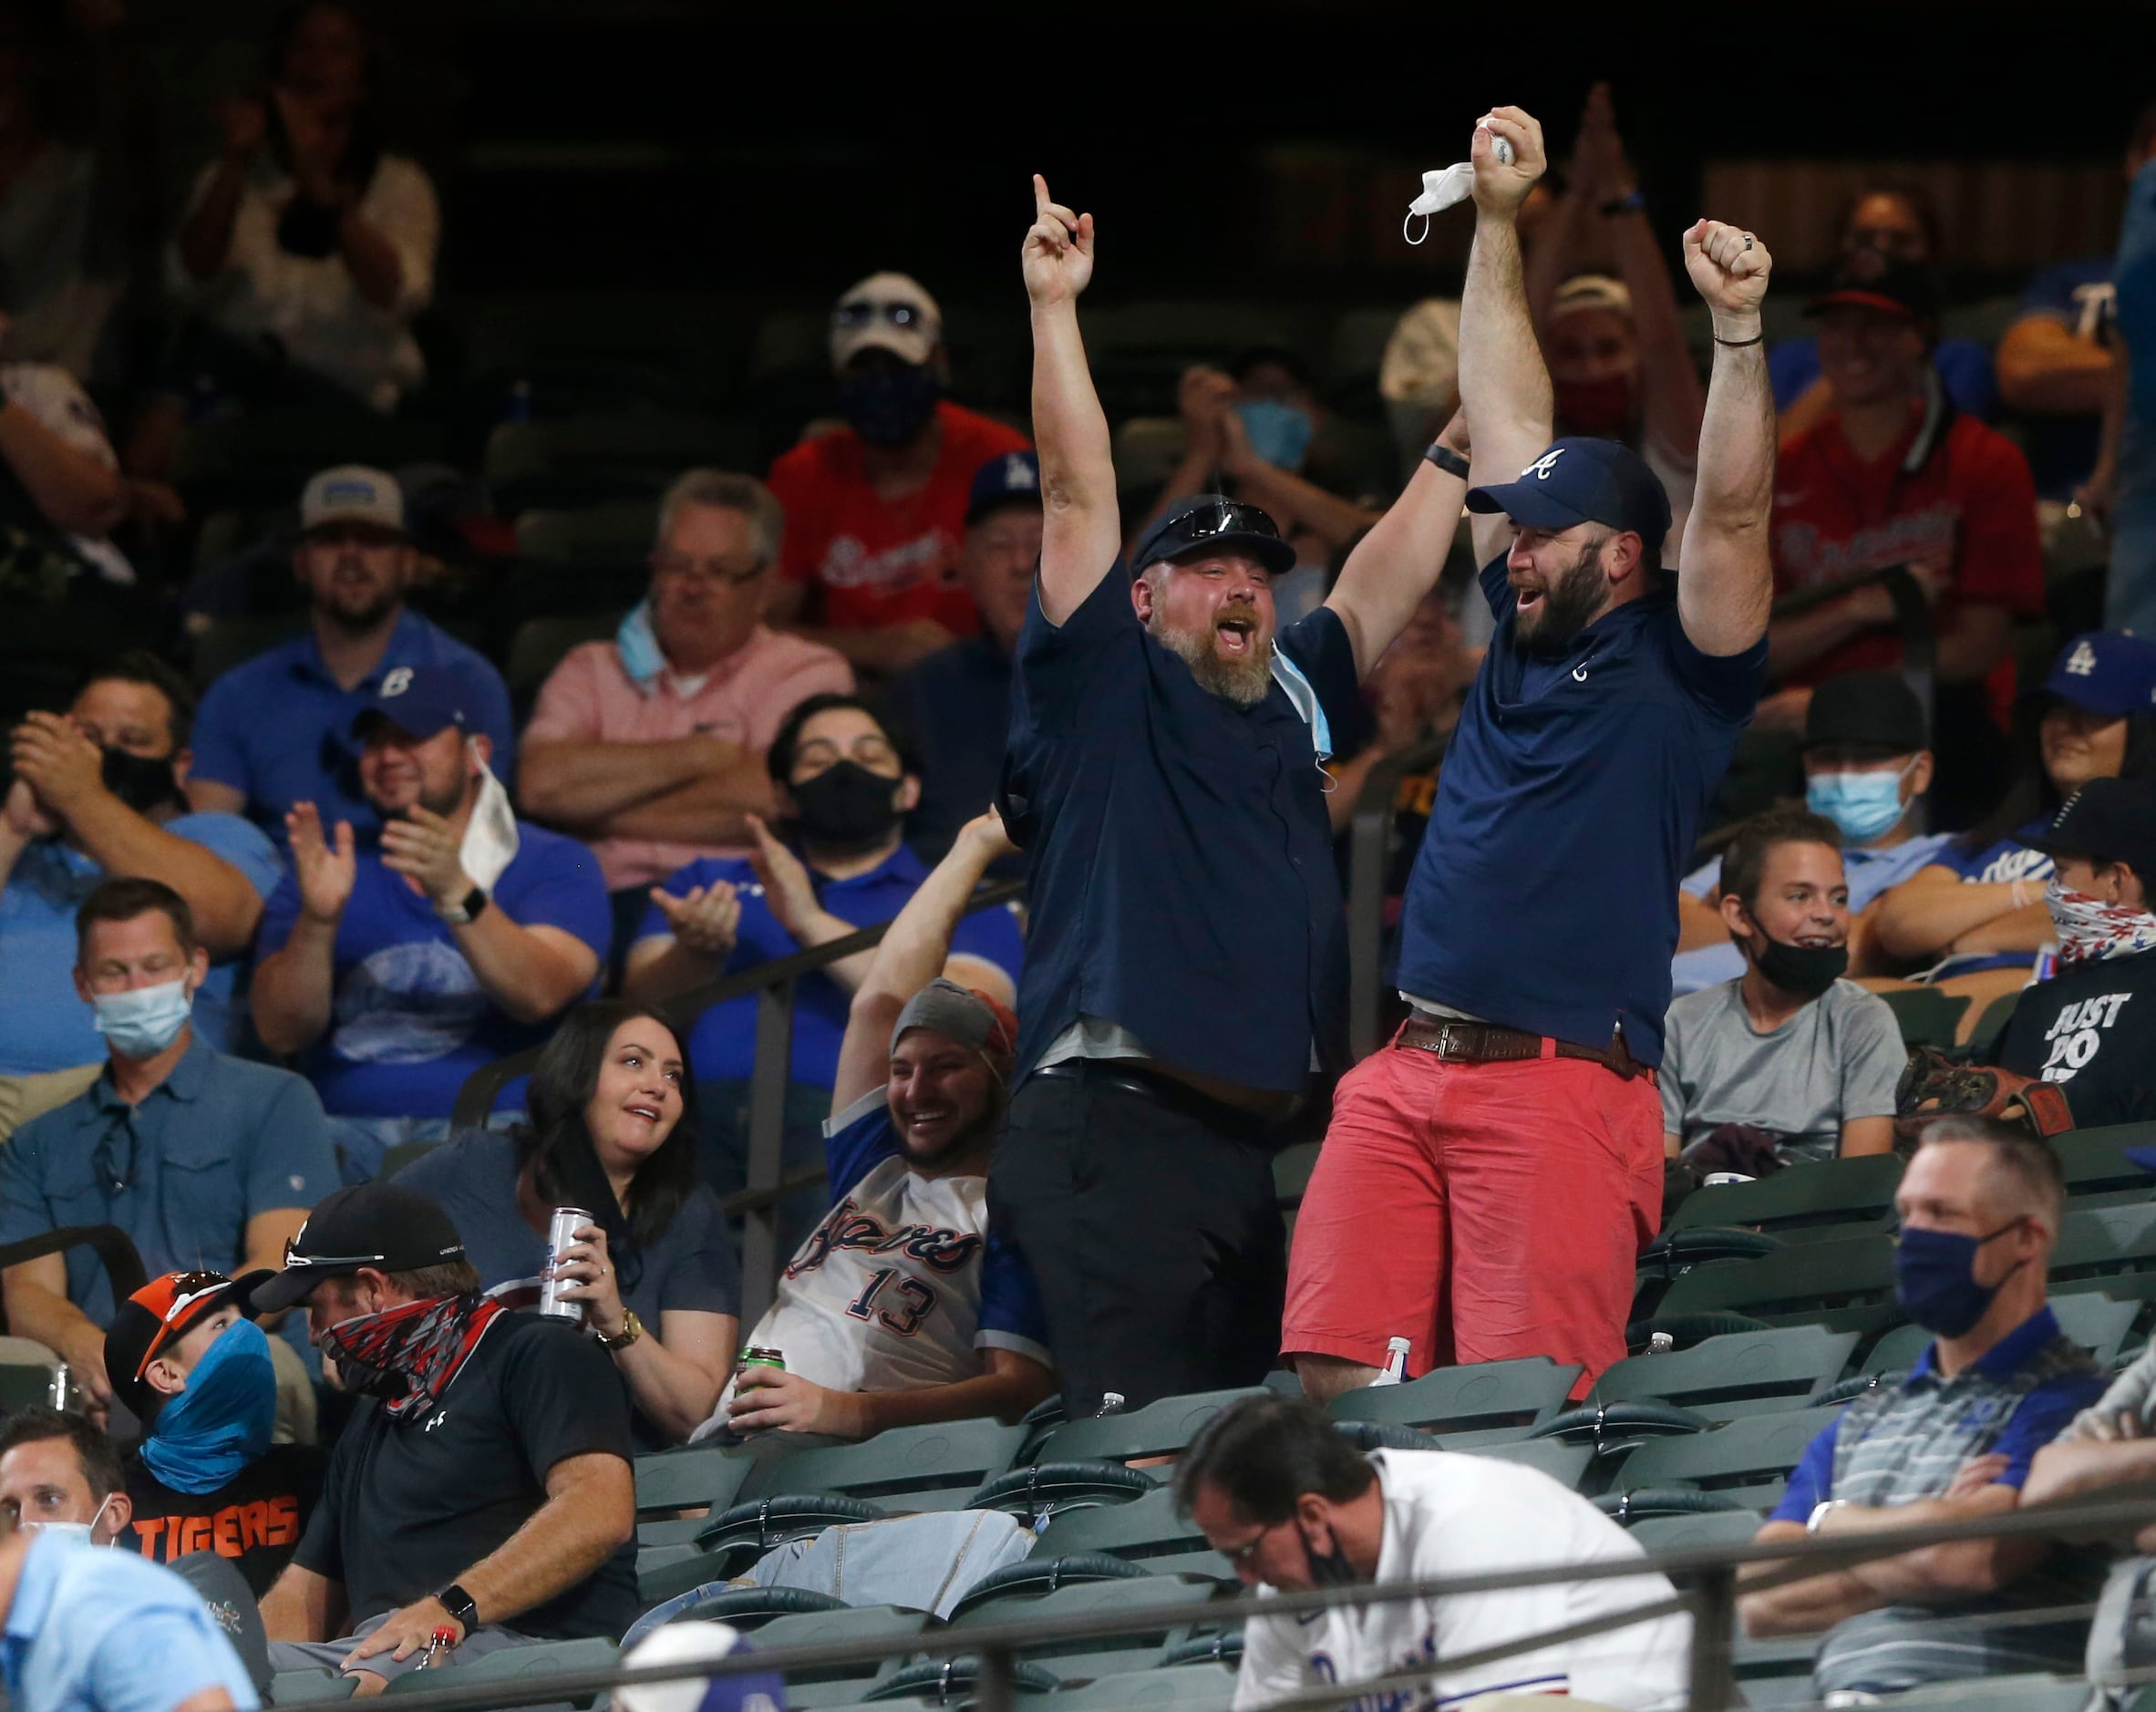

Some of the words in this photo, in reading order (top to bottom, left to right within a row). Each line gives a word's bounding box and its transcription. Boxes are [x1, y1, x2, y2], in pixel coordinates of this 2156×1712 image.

[1521, 448, 1565, 480] A
[379, 666, 415, 698] B
[2044, 992, 2133, 1041] JUST
[2040, 1027, 2100, 1070] DO
[844, 1267, 938, 1337] 13
[131, 1494, 299, 1564] TIGERS
